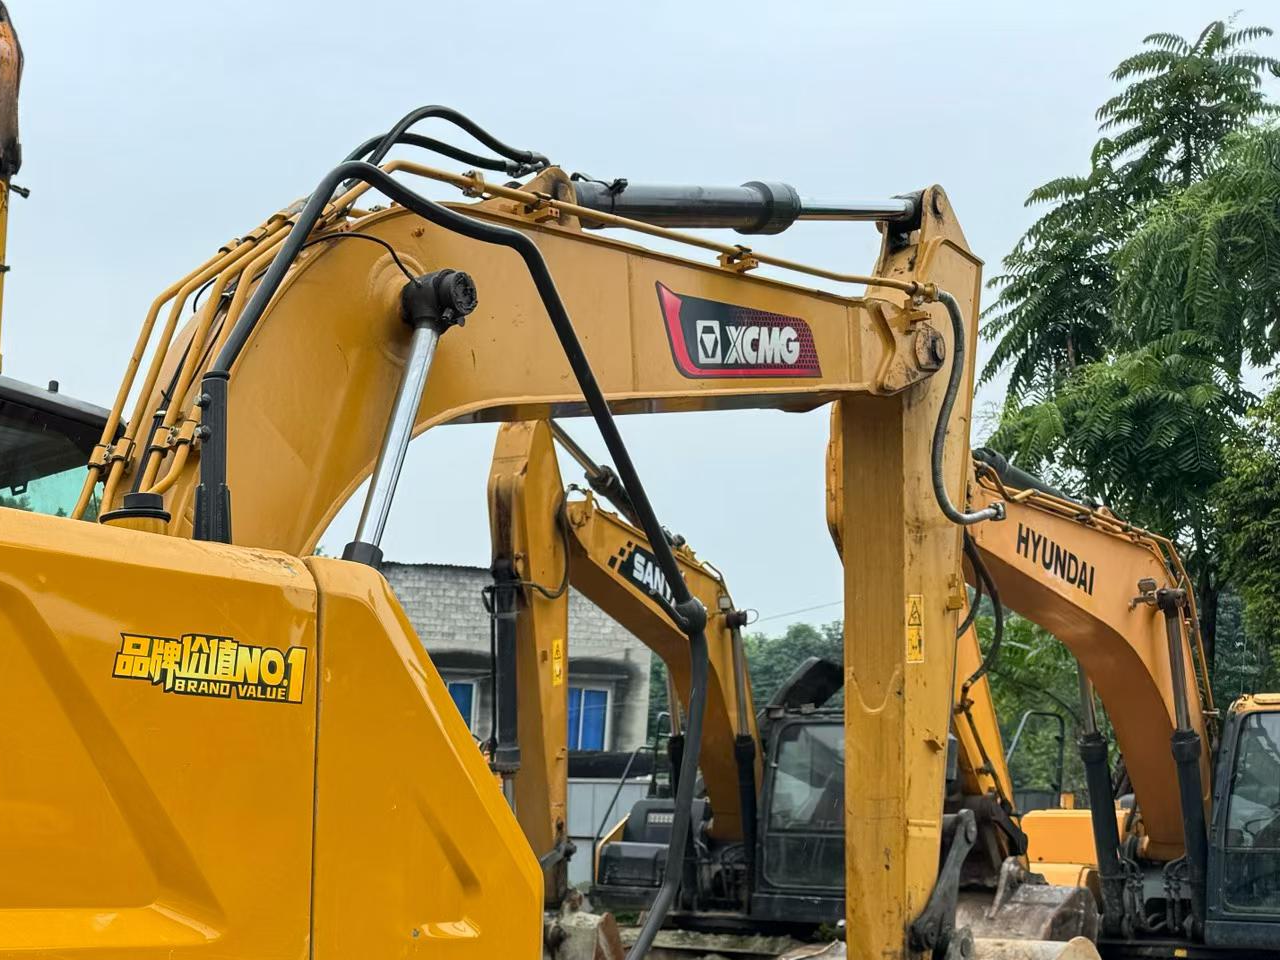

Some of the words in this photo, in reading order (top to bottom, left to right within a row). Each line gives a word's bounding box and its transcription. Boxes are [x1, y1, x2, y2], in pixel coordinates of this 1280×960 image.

[723, 325, 800, 365] XCMG
[1016, 522, 1095, 597] HYUNDAI
[175, 678, 230, 696] BRAND
[238, 684, 287, 700] VALUE
